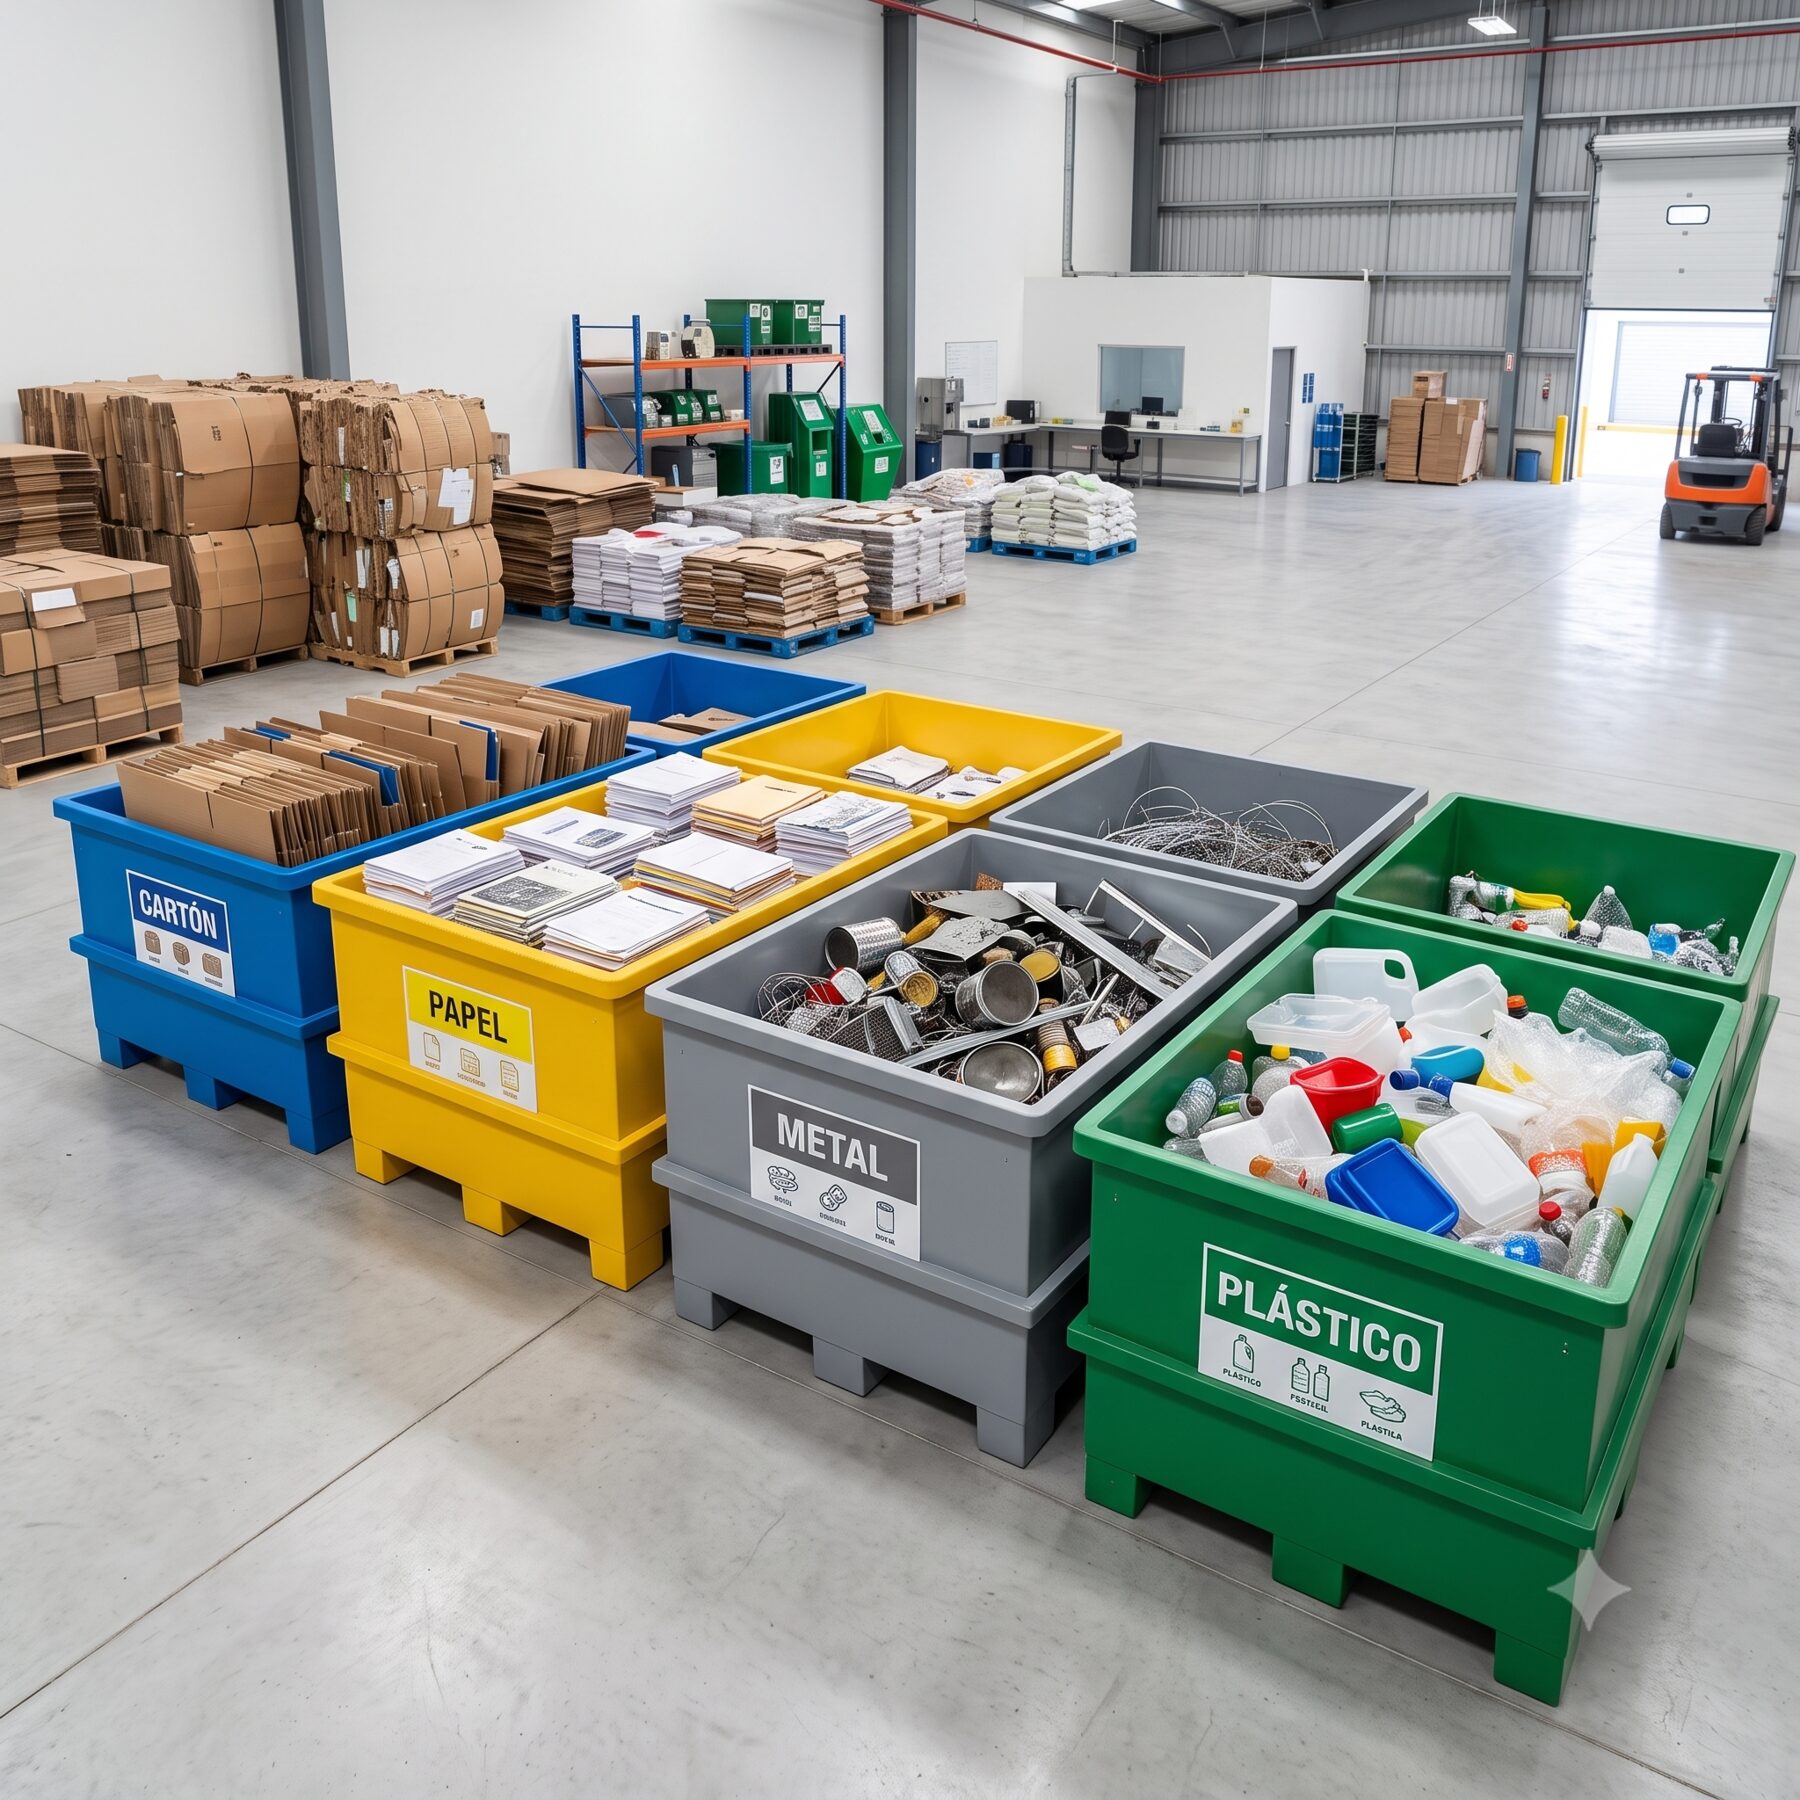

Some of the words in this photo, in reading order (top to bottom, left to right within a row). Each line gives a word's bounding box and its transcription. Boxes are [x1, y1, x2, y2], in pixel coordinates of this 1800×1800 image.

[139, 888, 218, 940] CARTÓN
[429, 989, 508, 1044] PAPEL
[777, 1112, 888, 1182] METAL
[1217, 1271, 1422, 1373] PLÁSTICO
